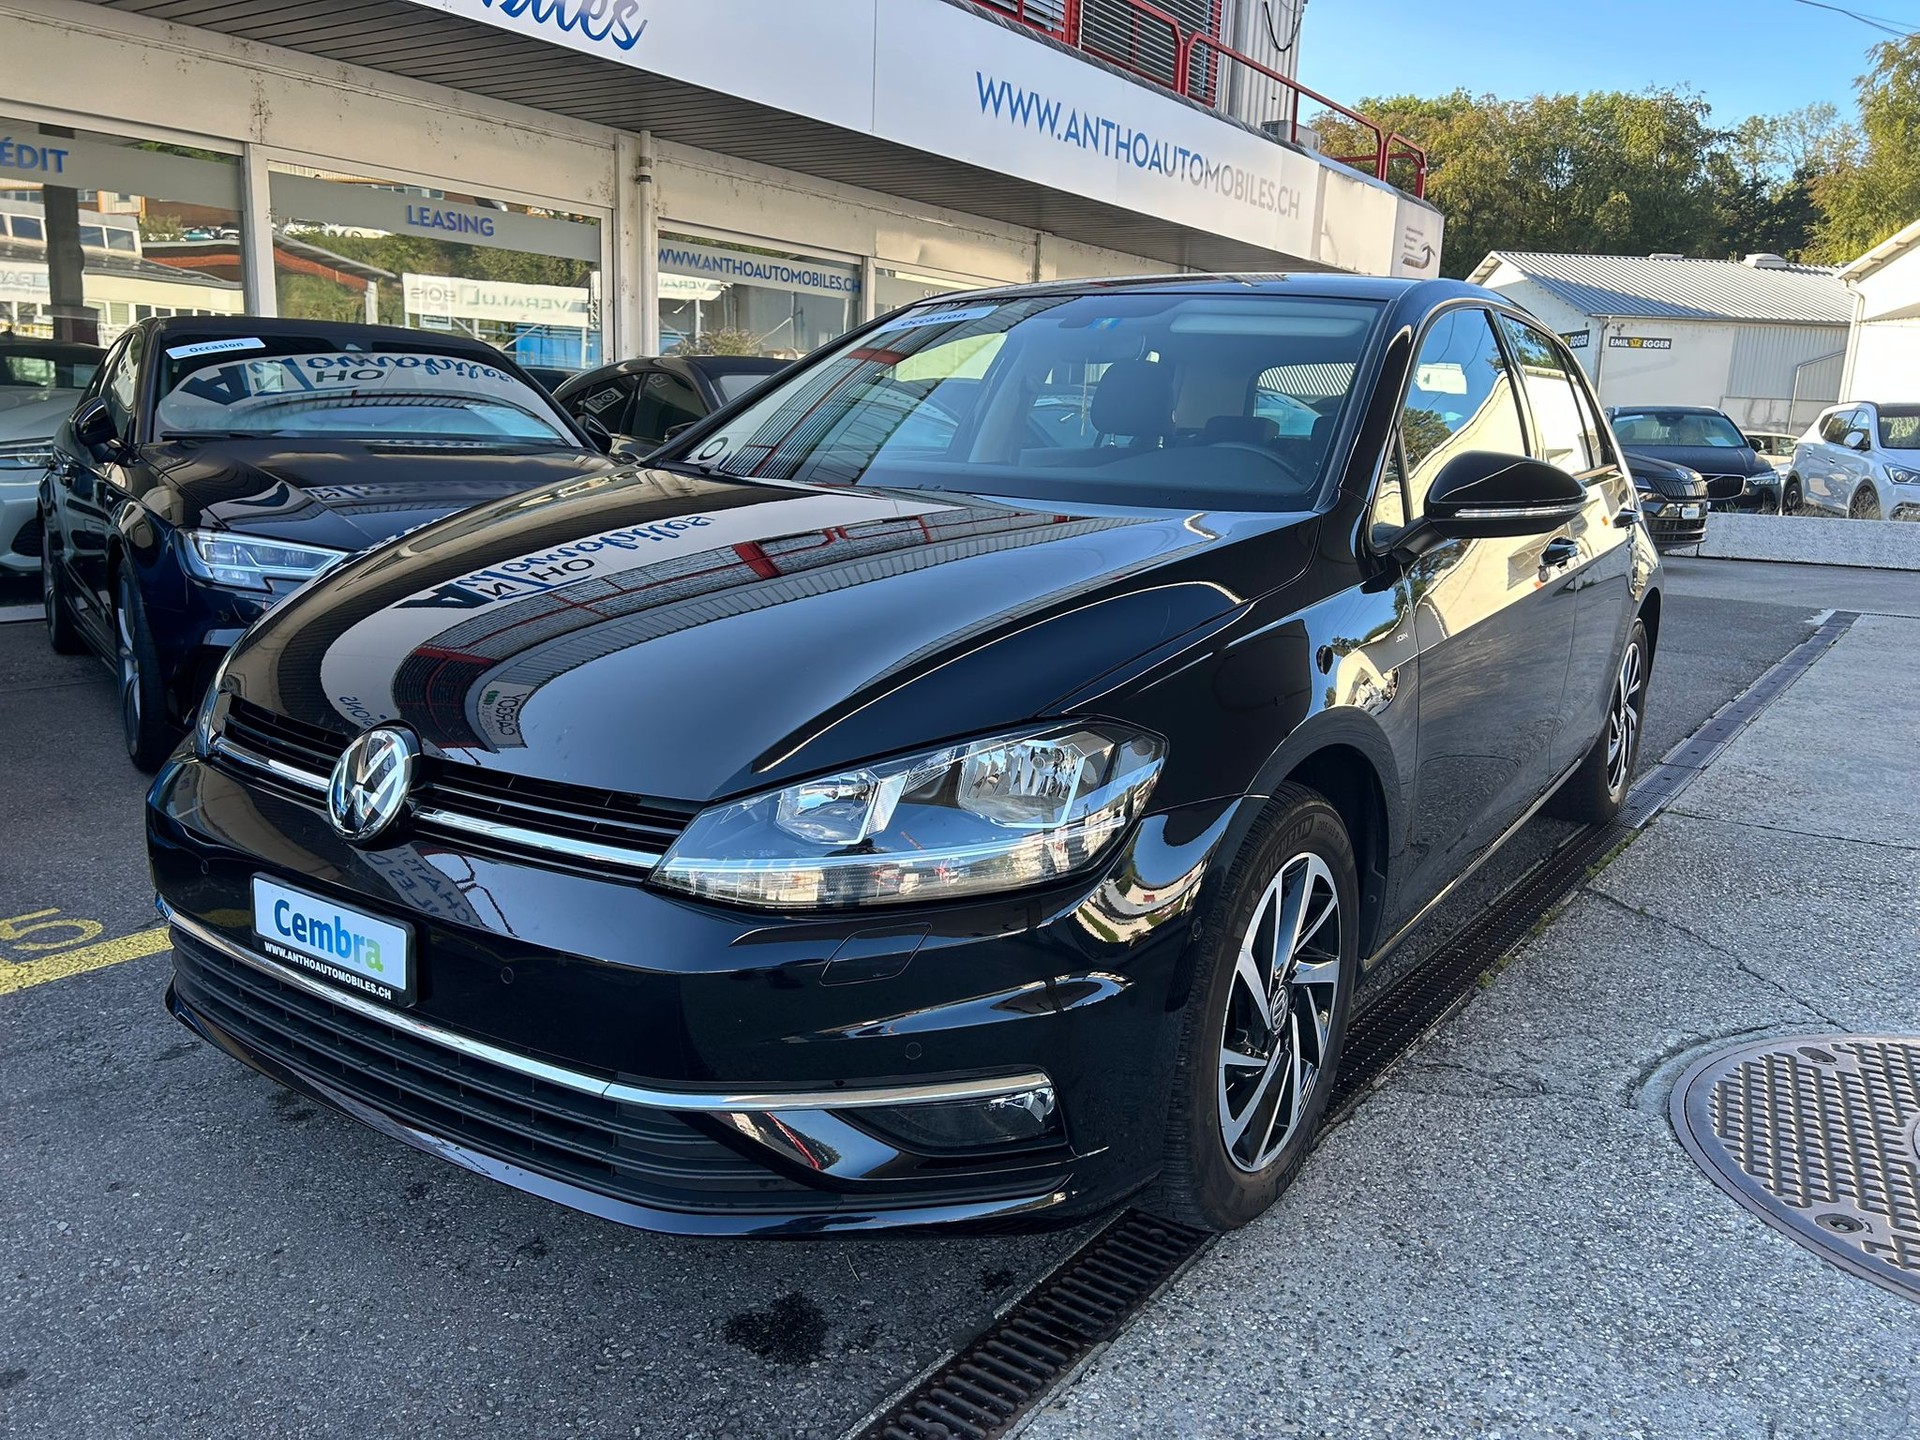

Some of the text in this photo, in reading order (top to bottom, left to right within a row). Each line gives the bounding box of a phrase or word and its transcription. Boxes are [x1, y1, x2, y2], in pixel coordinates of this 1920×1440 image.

[976, 71, 1300, 219] WWW.ANTHOAUTOMOBILES.CH
[407, 204, 495, 237] LEASING
[658, 247, 861, 294] WWW.ANTHOAUTOMOBILES.CH
[901, 312, 968, 327] Occasion
[189, 340, 244, 354] Occasion
[1569, 335, 1588, 347] EGGER
[1610, 339, 1670, 349] EMIL EGGER
[274, 898, 385, 973] Cembra
[264, 941, 392, 1001] WWW.ANTHOAUTOMOBILES.CH
